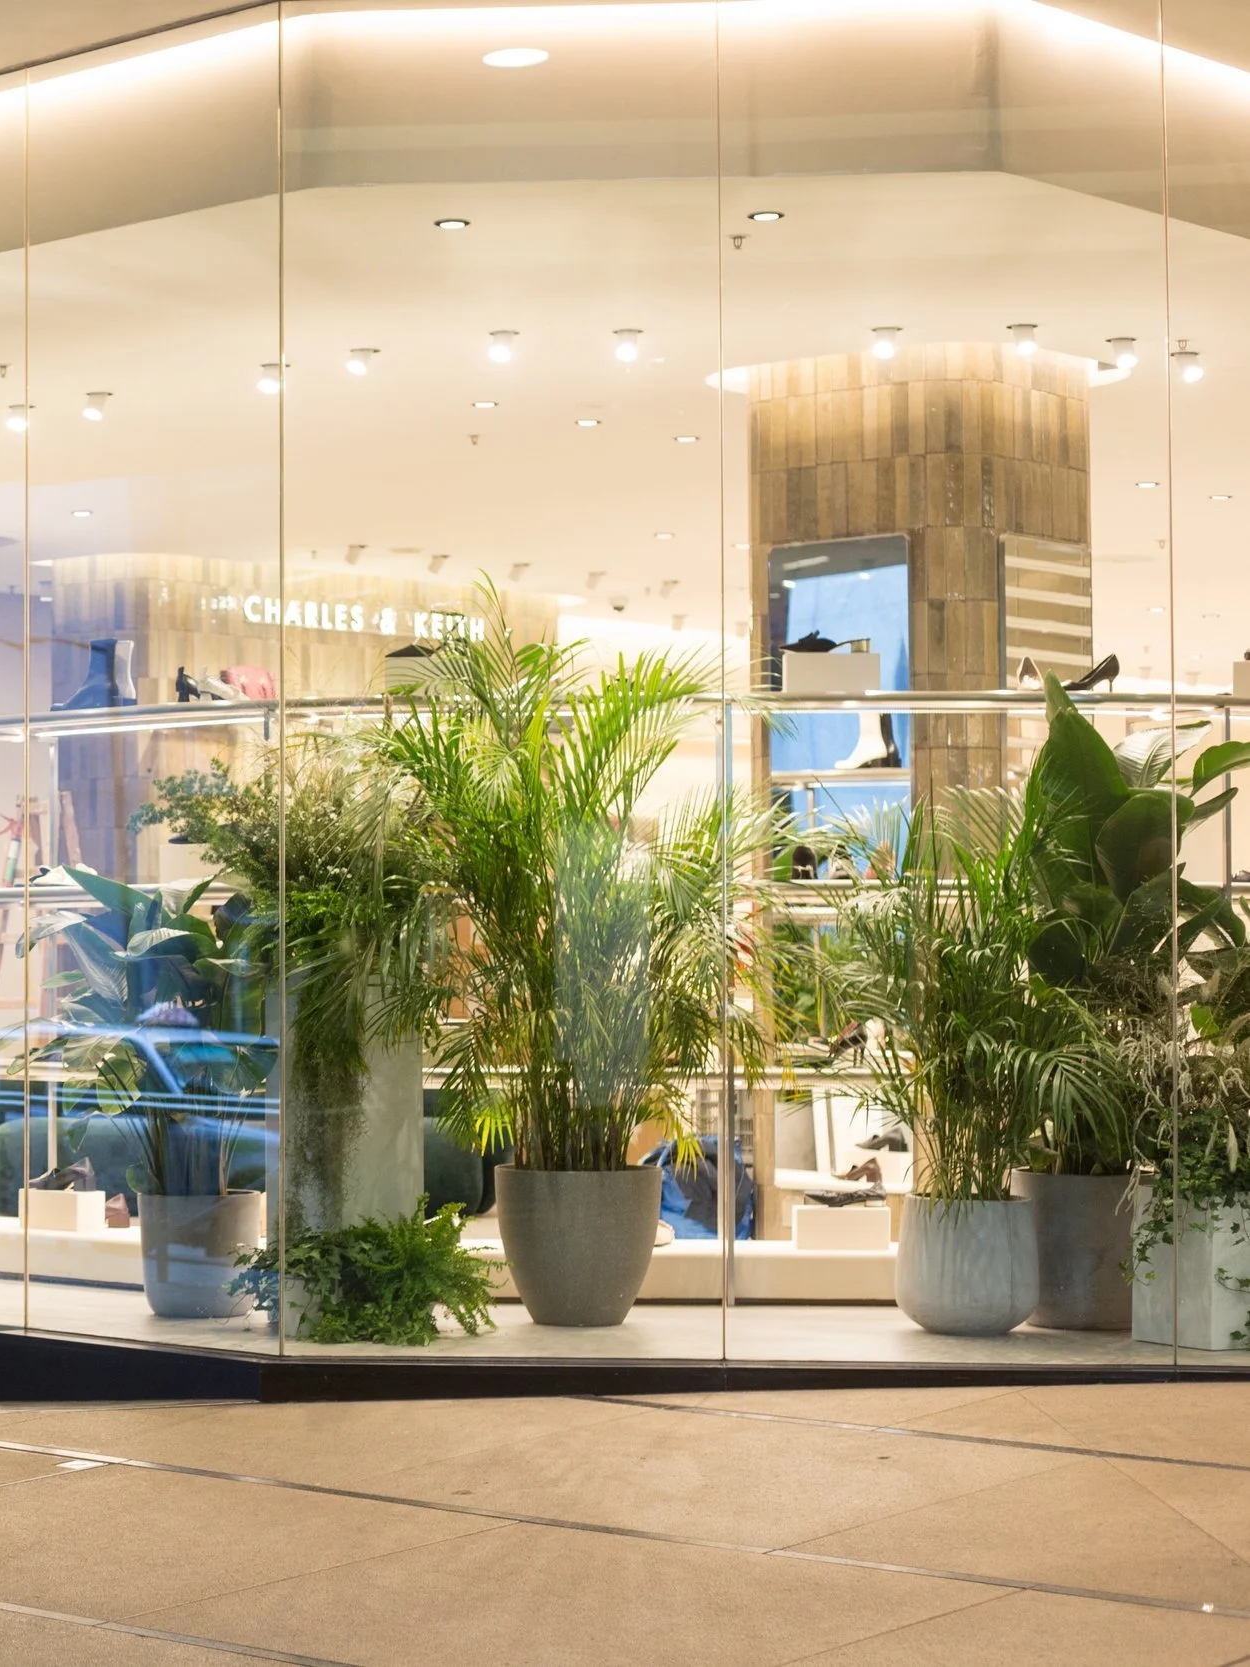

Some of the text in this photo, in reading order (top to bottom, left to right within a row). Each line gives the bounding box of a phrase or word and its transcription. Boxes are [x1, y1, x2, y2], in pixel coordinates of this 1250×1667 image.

[243, 595, 485, 643] CHARLES & KEITH
